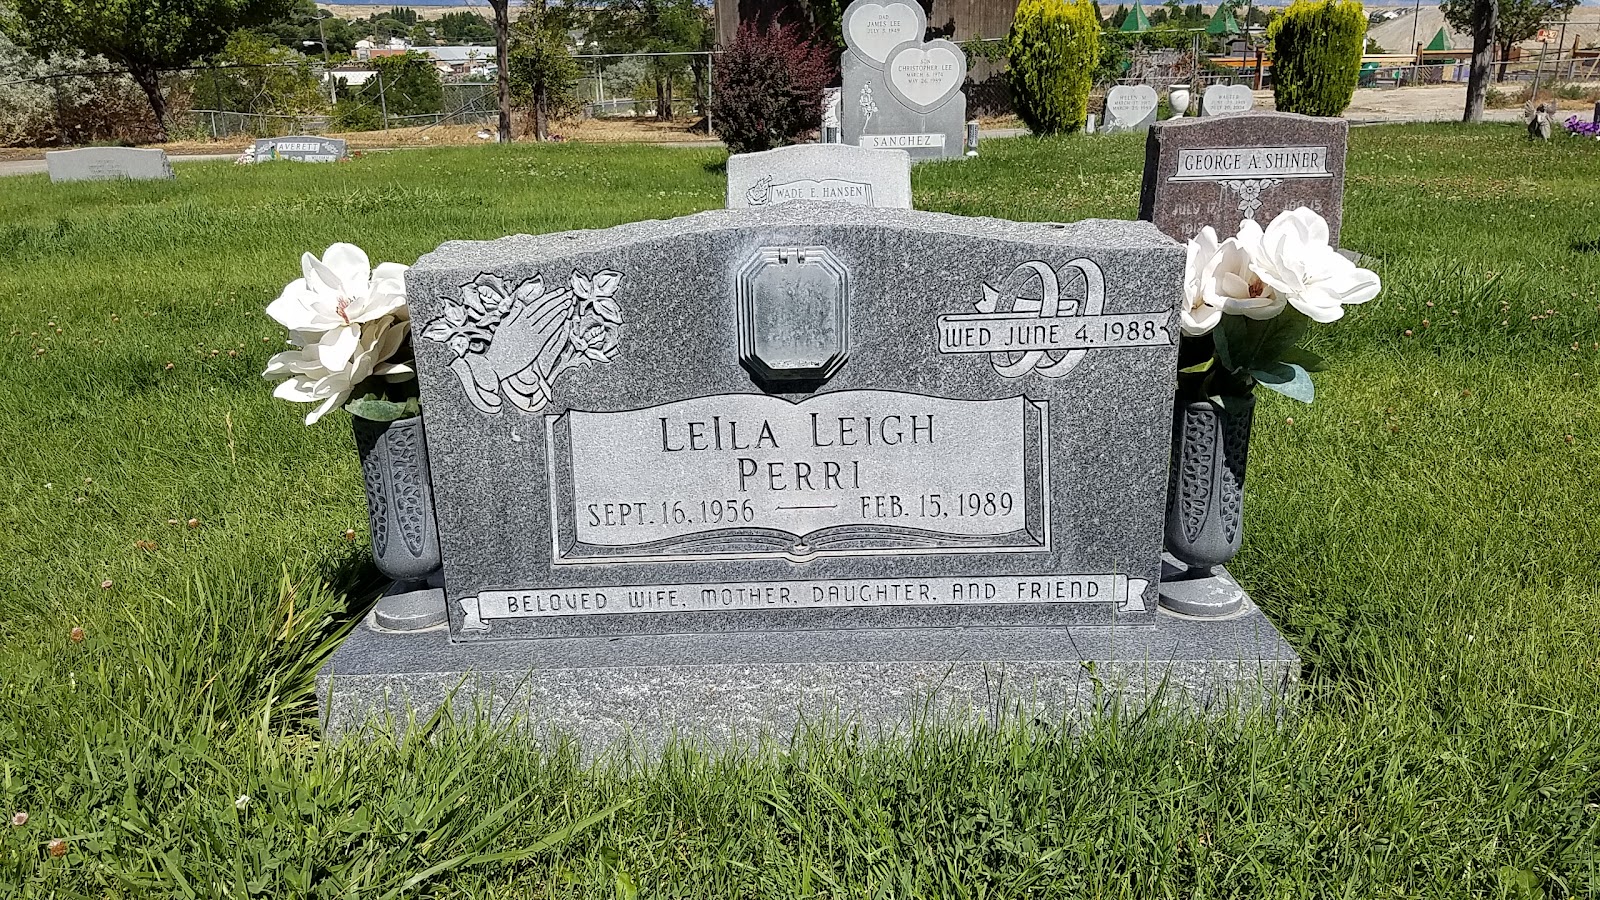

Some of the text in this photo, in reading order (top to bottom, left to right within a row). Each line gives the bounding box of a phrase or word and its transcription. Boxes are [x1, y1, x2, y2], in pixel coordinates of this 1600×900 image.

[278, 143, 318, 151] AVERETT
[873, 135, 931, 147] SANCHEZ
[1184, 152, 1319, 170] GEORGE A. SHINER
[776, 186, 862, 198] WADE E. HANSEN
[1172, 202, 1201, 216] JULY
[945, 328, 991, 348] WED
[1004, 325, 1059, 346] JUNE
[1104, 322, 1156, 342] 1988
[660, 413, 935, 453] LEILA LEIGH
[738, 458, 860, 492] PERRI
[588, 502, 654, 527] SEPT.
[700, 498, 754, 524] 1956
[860, 496, 909, 518] FEB.
[919, 494, 948, 518] 15,
[957, 492, 1013, 517] 1989
[508, 594, 608, 612] BELOVED
[952, 582, 996, 600] AND
[1018, 581, 1099, 599] FRIEND
